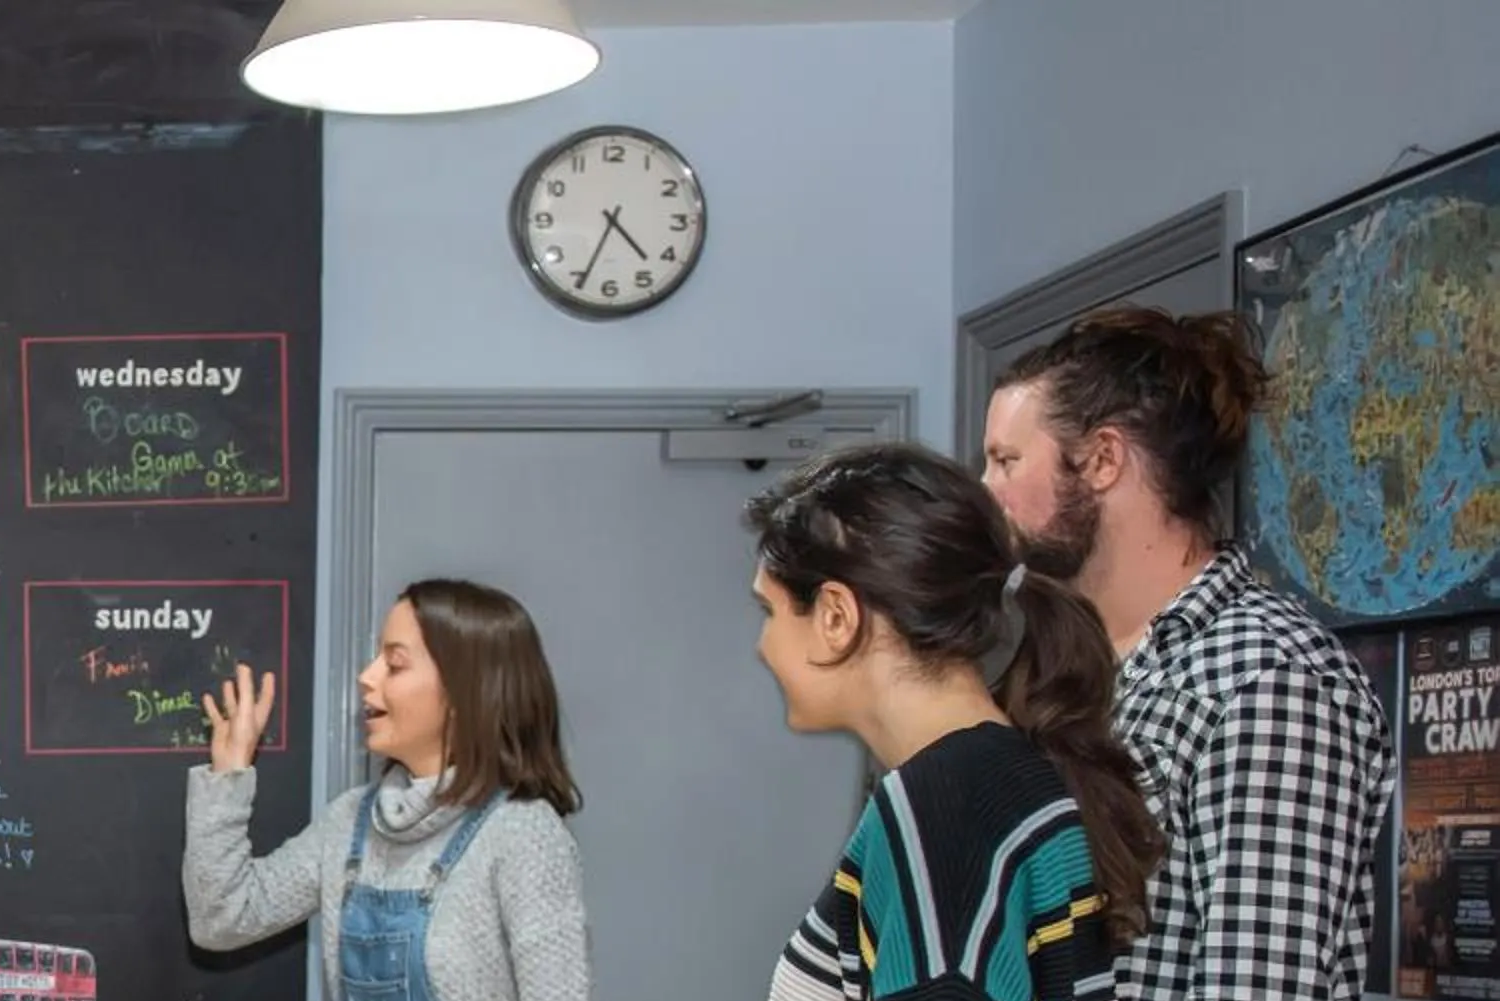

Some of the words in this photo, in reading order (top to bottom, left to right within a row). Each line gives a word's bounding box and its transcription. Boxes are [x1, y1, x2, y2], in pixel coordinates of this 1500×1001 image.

[602, 145, 625, 163] 12
[644, 154, 651, 171] 1
[572, 155, 586, 173] 11
[548, 180, 565, 197] 10
[660, 179, 678, 197] 2
[535, 212, 553, 229] 9
[669, 214, 688, 231] 3
[660, 245, 676, 262] 4
[570, 270, 588, 289] 7
[601, 280, 619, 297] 6
[635, 271, 653, 288] 5
[75, 359, 243, 396] wednesday
[94, 599, 213, 639] sunday
[1410, 668, 1473, 692] LONDON'S
[1408, 685, 1494, 725] PARTY
